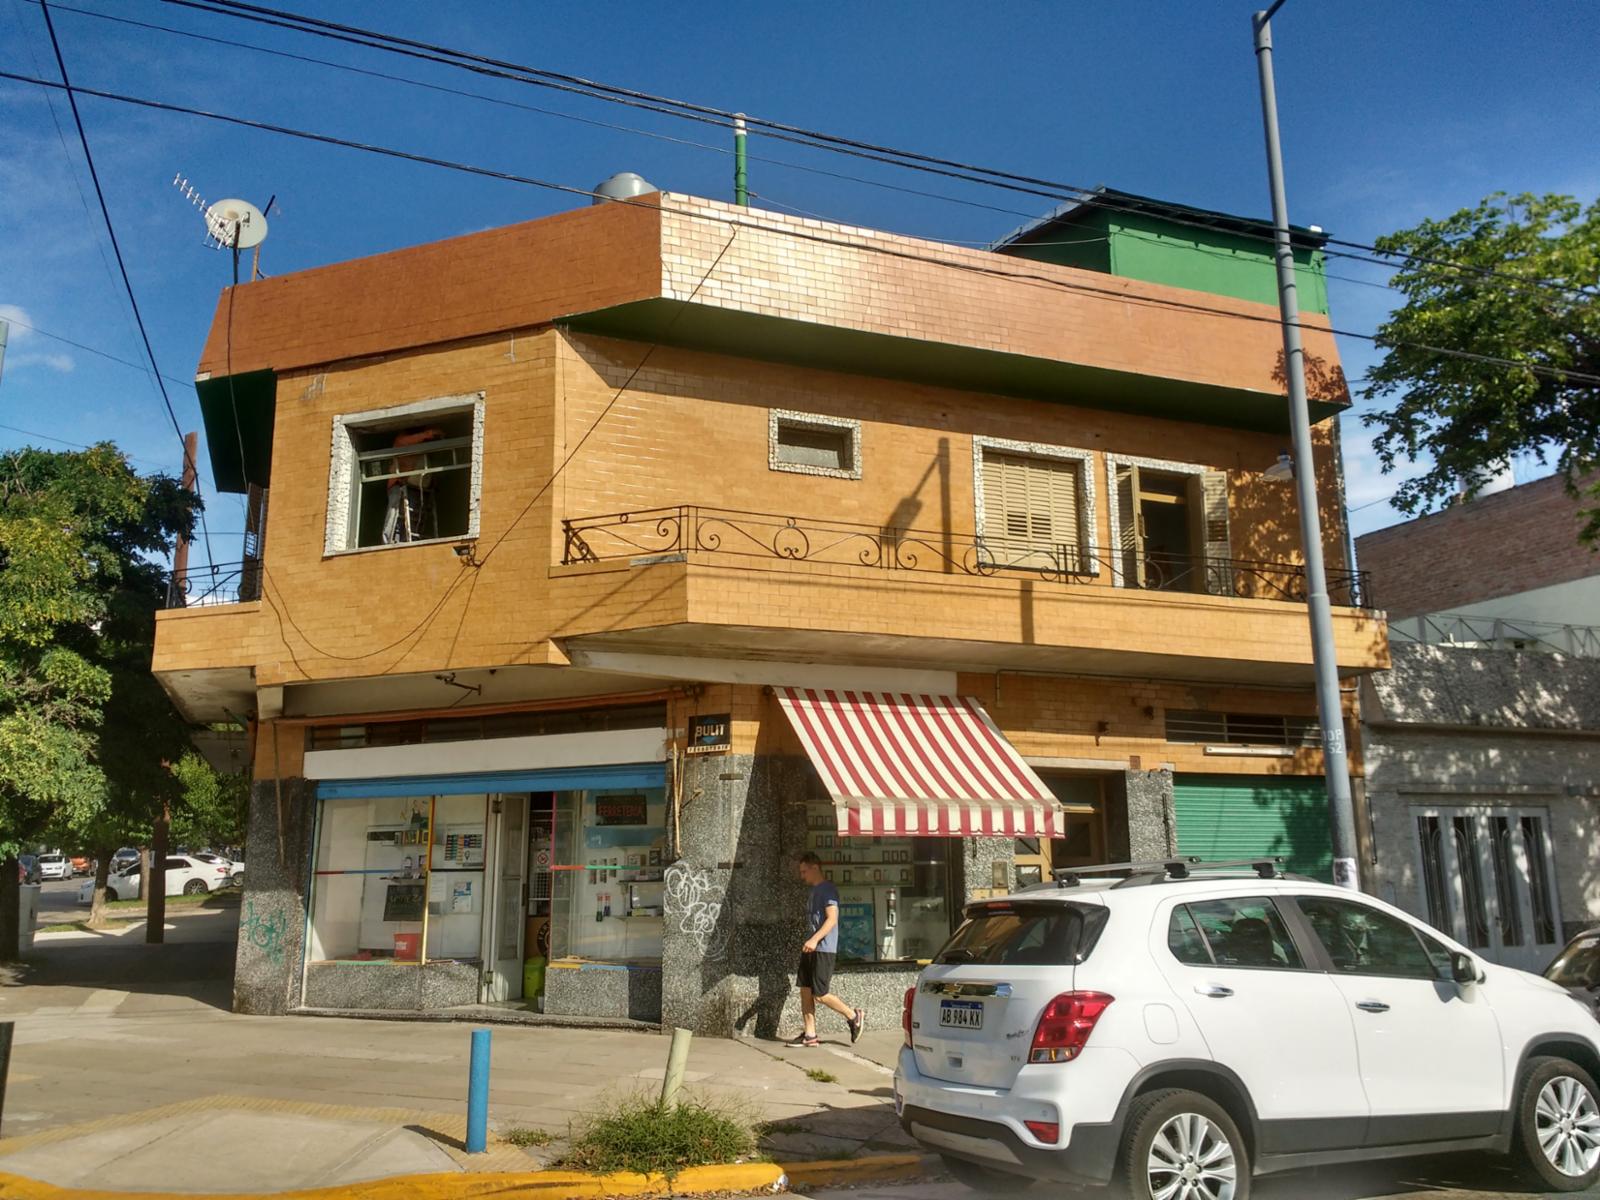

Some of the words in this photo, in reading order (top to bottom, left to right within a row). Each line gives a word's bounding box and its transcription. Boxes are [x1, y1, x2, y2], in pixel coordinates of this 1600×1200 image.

[941, 1008, 952, 1024] AB
[953, 1009, 968, 1025] 984
[970, 1010, 980, 1027] KX
